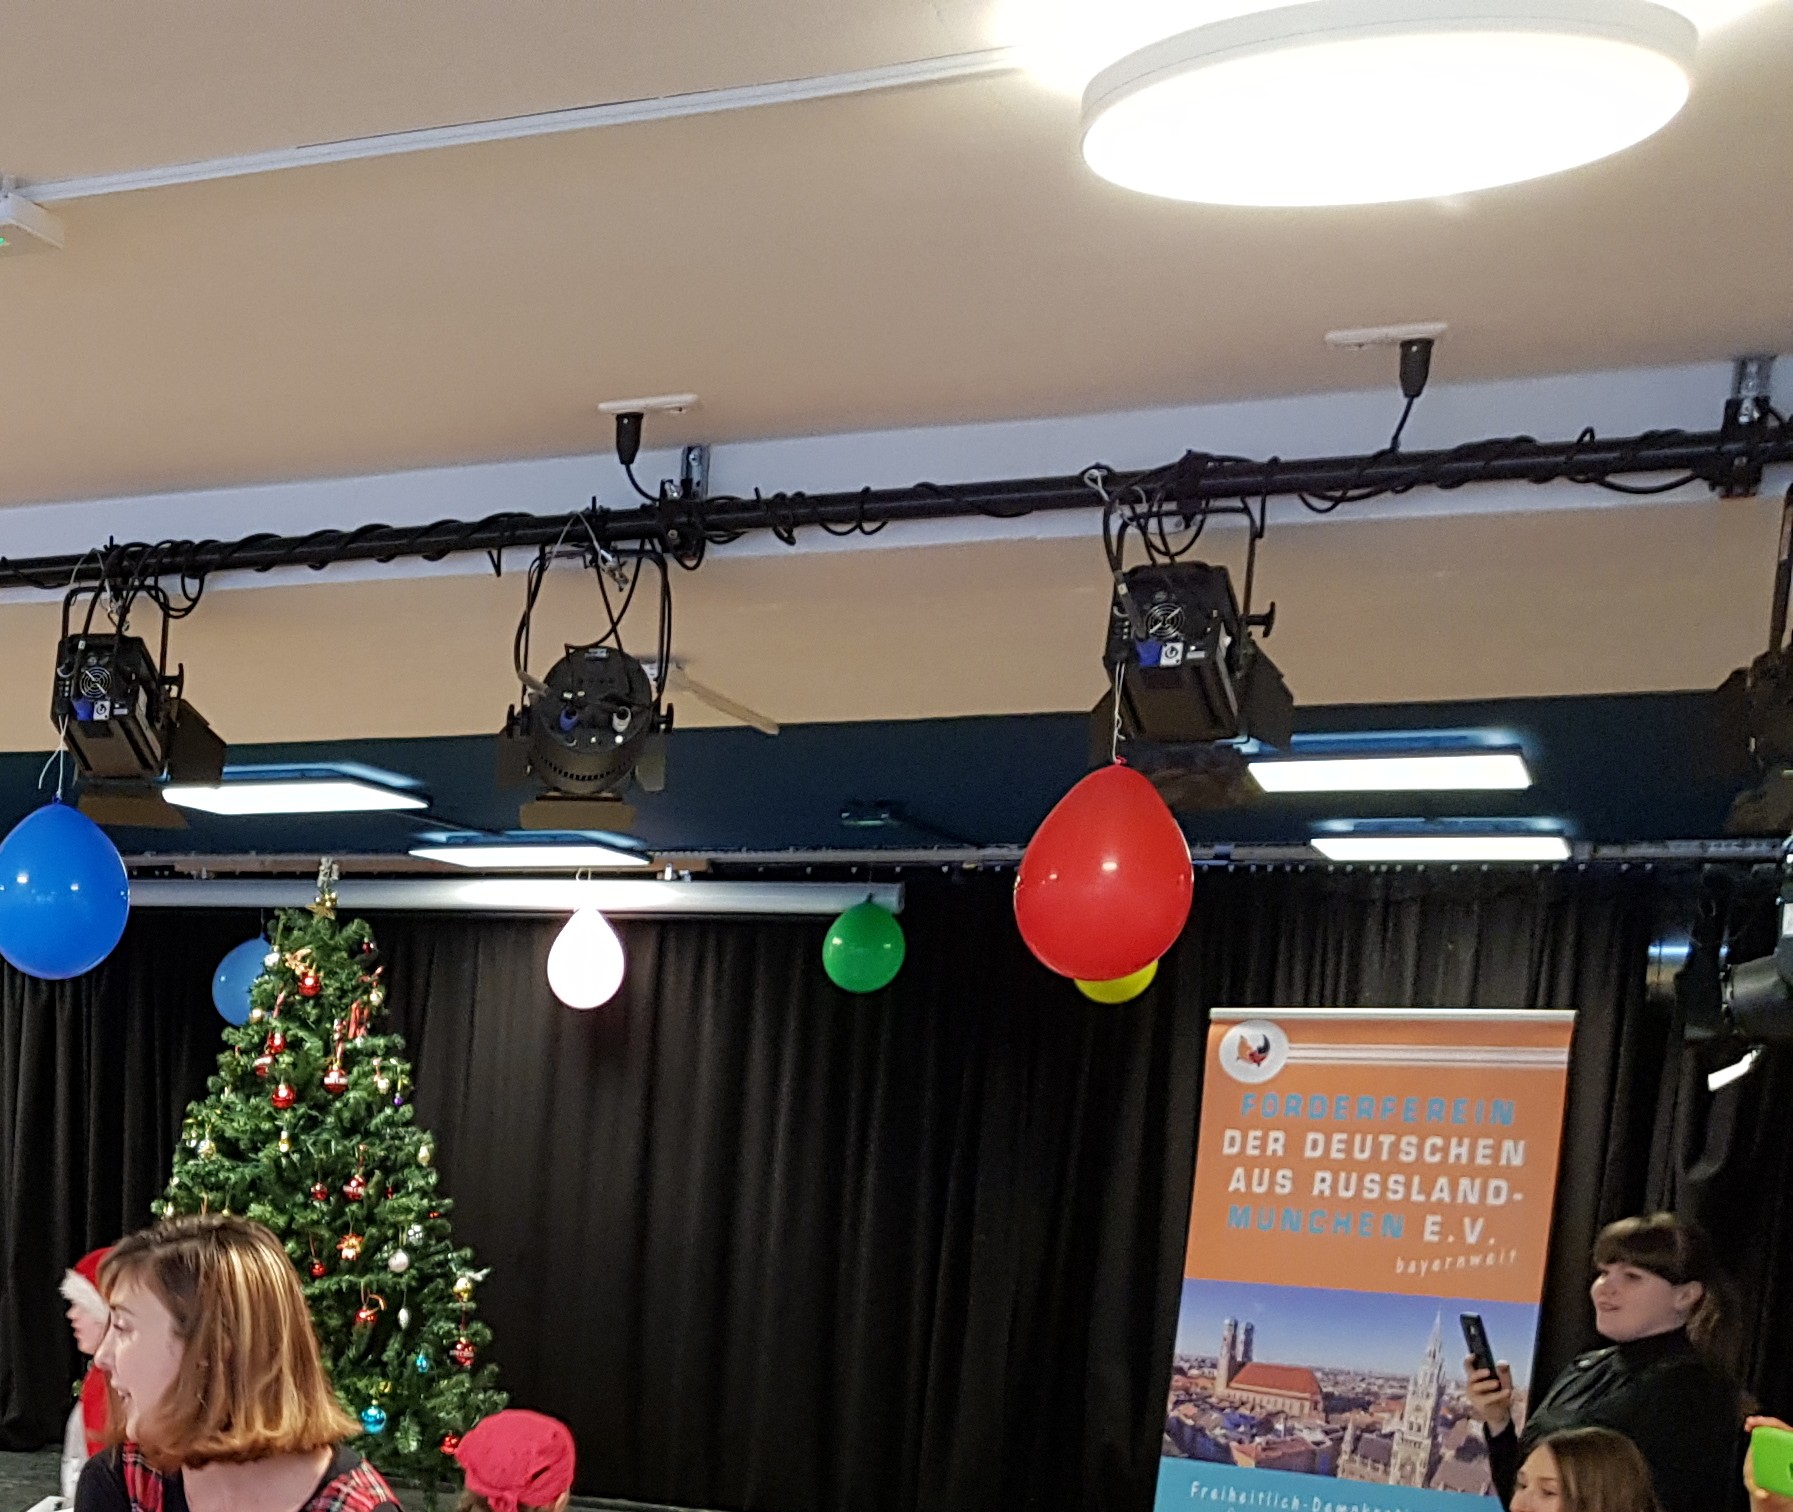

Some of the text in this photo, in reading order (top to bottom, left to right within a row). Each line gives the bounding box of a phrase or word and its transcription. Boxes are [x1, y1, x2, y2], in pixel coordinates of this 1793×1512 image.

[1222, 1128, 1526, 1168] DER DEUTSCHEN
[1228, 1166, 1525, 1206] AUS RUSSLAND-
